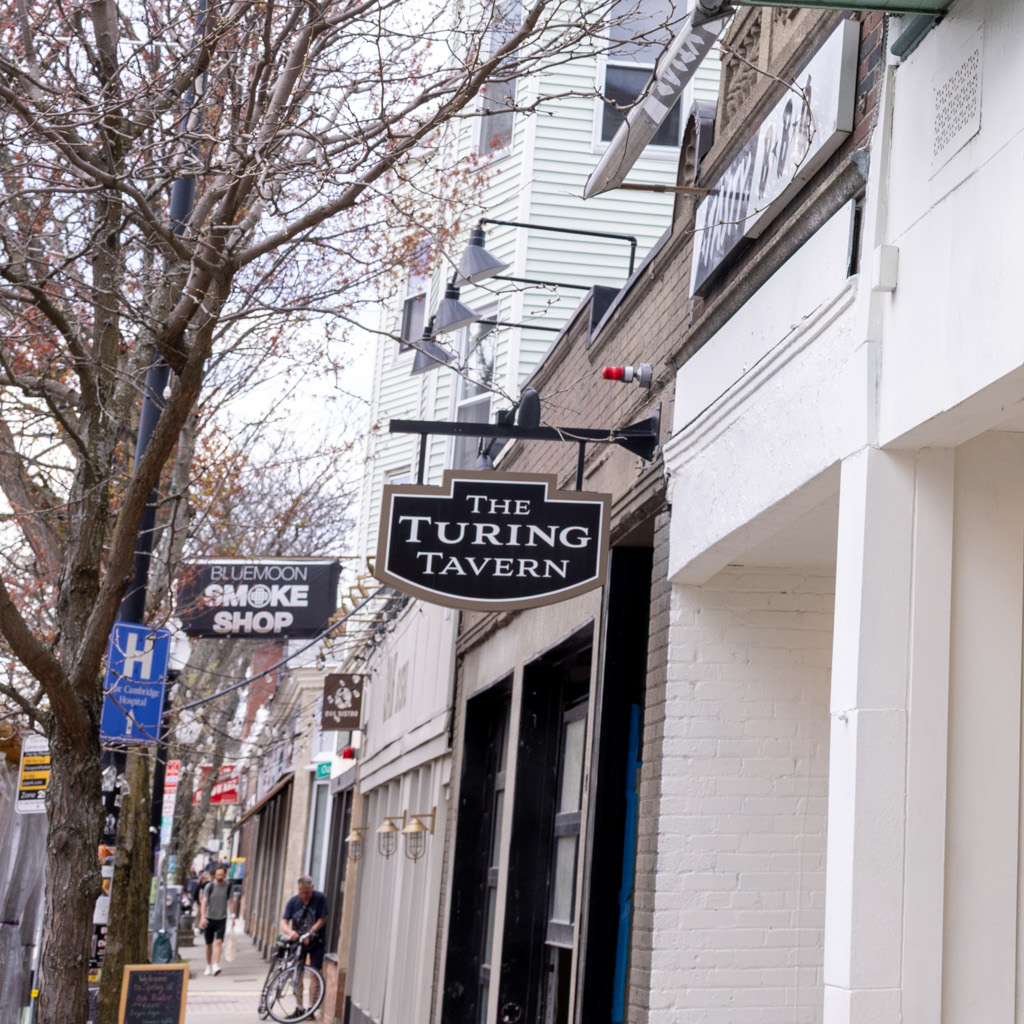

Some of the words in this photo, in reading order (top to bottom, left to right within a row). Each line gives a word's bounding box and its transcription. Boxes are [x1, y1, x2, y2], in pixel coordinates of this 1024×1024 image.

[466, 494, 531, 515] THE
[398, 515, 592, 549] TURING
[210, 565, 308, 581] BLUEMOON
[416, 551, 570, 579] TAVERN
[203, 583, 310, 608] SMOKE
[212, 610, 294, 633] SHOP
[122, 632, 156, 680] H
[120, 695, 147, 707] Hospital
[124, 685, 160, 699] Cambridge
[21, 791, 36, 799] Zone
